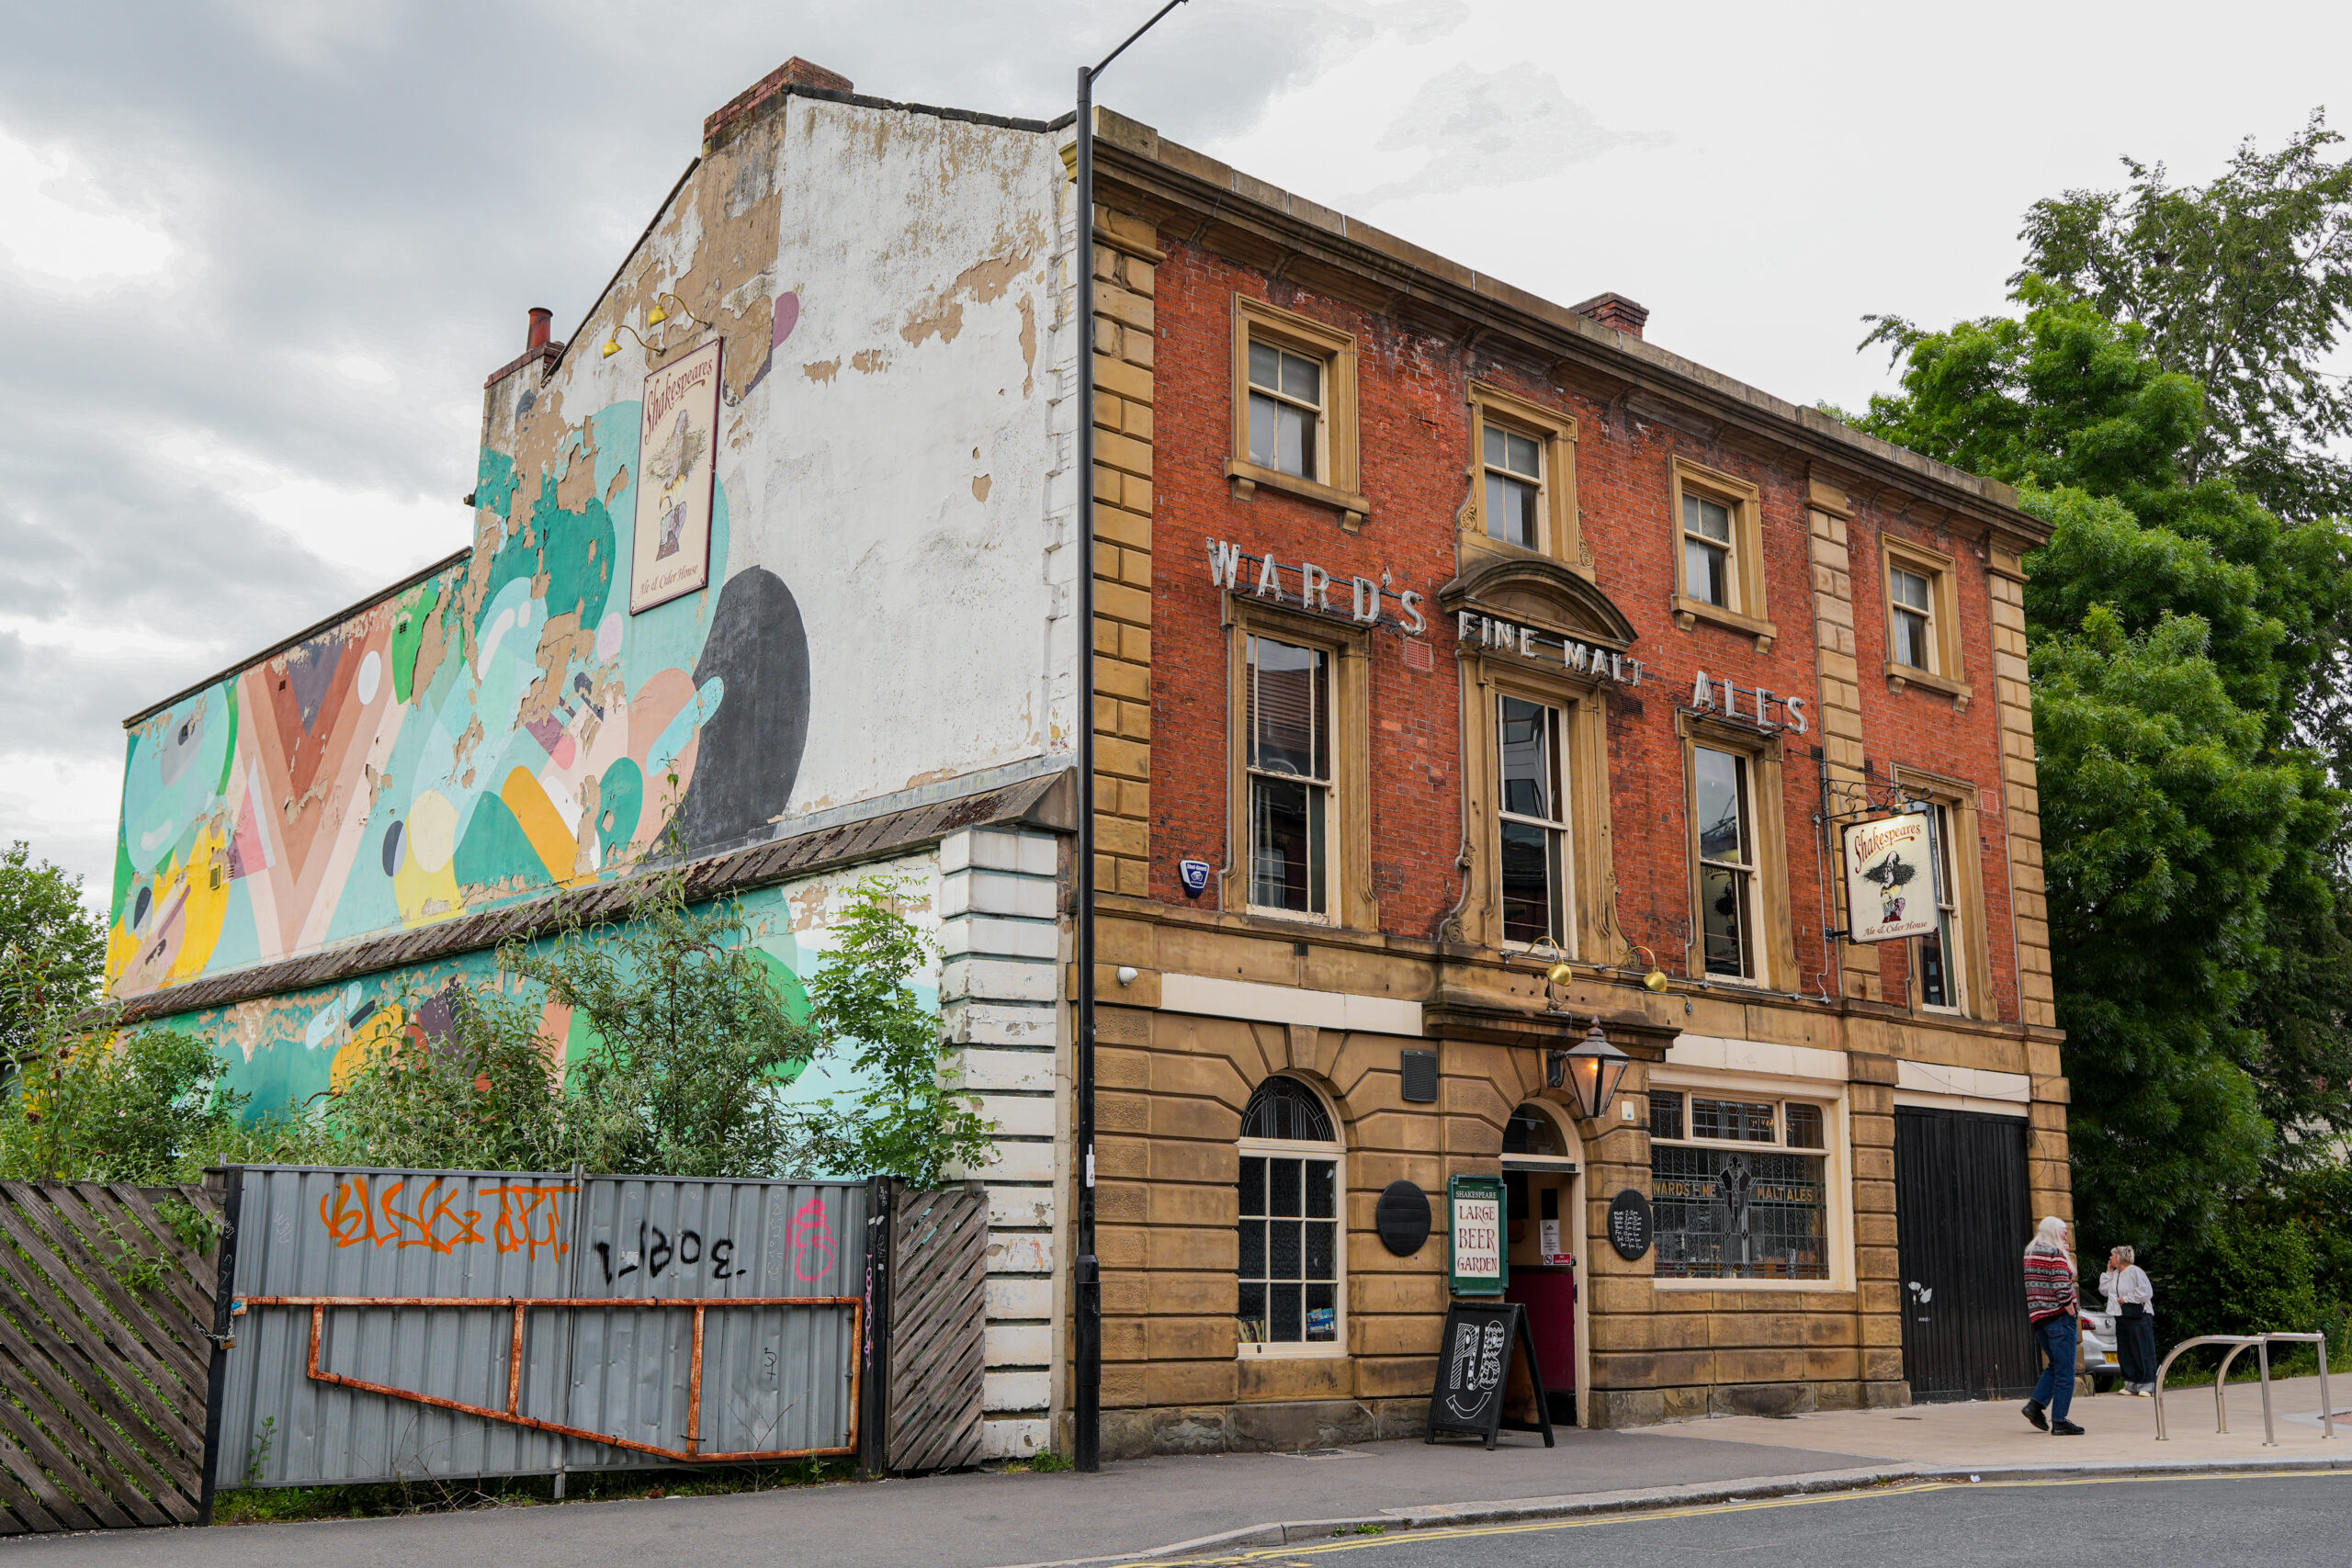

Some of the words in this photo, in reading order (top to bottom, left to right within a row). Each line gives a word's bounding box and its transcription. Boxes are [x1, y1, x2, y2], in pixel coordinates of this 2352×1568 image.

[644, 358, 713, 446] Shakespeares
[1205, 536, 1427, 637] WARD'S
[1458, 610, 1541, 660] FINE
[1563, 639, 1647, 687] MALT
[1692, 671, 1809, 736] ALES
[1854, 823, 1922, 874] Shakespeares
[1863, 926, 1876, 937] Ale
[1886, 923, 1904, 934] Cider
[1905, 920, 1928, 931] House
[1455, 1190, 1497, 1199] SHAKESPEARE
[1757, 1185, 1784, 1201] MALT
[1786, 1187, 1814, 1202] ALES
[1459, 1205, 1495, 1225] LARGE
[1458, 1228, 1498, 1253] BEER
[1457, 1257, 1498, 1273] GARDEN
[1450, 1320, 1505, 1391] PUB
